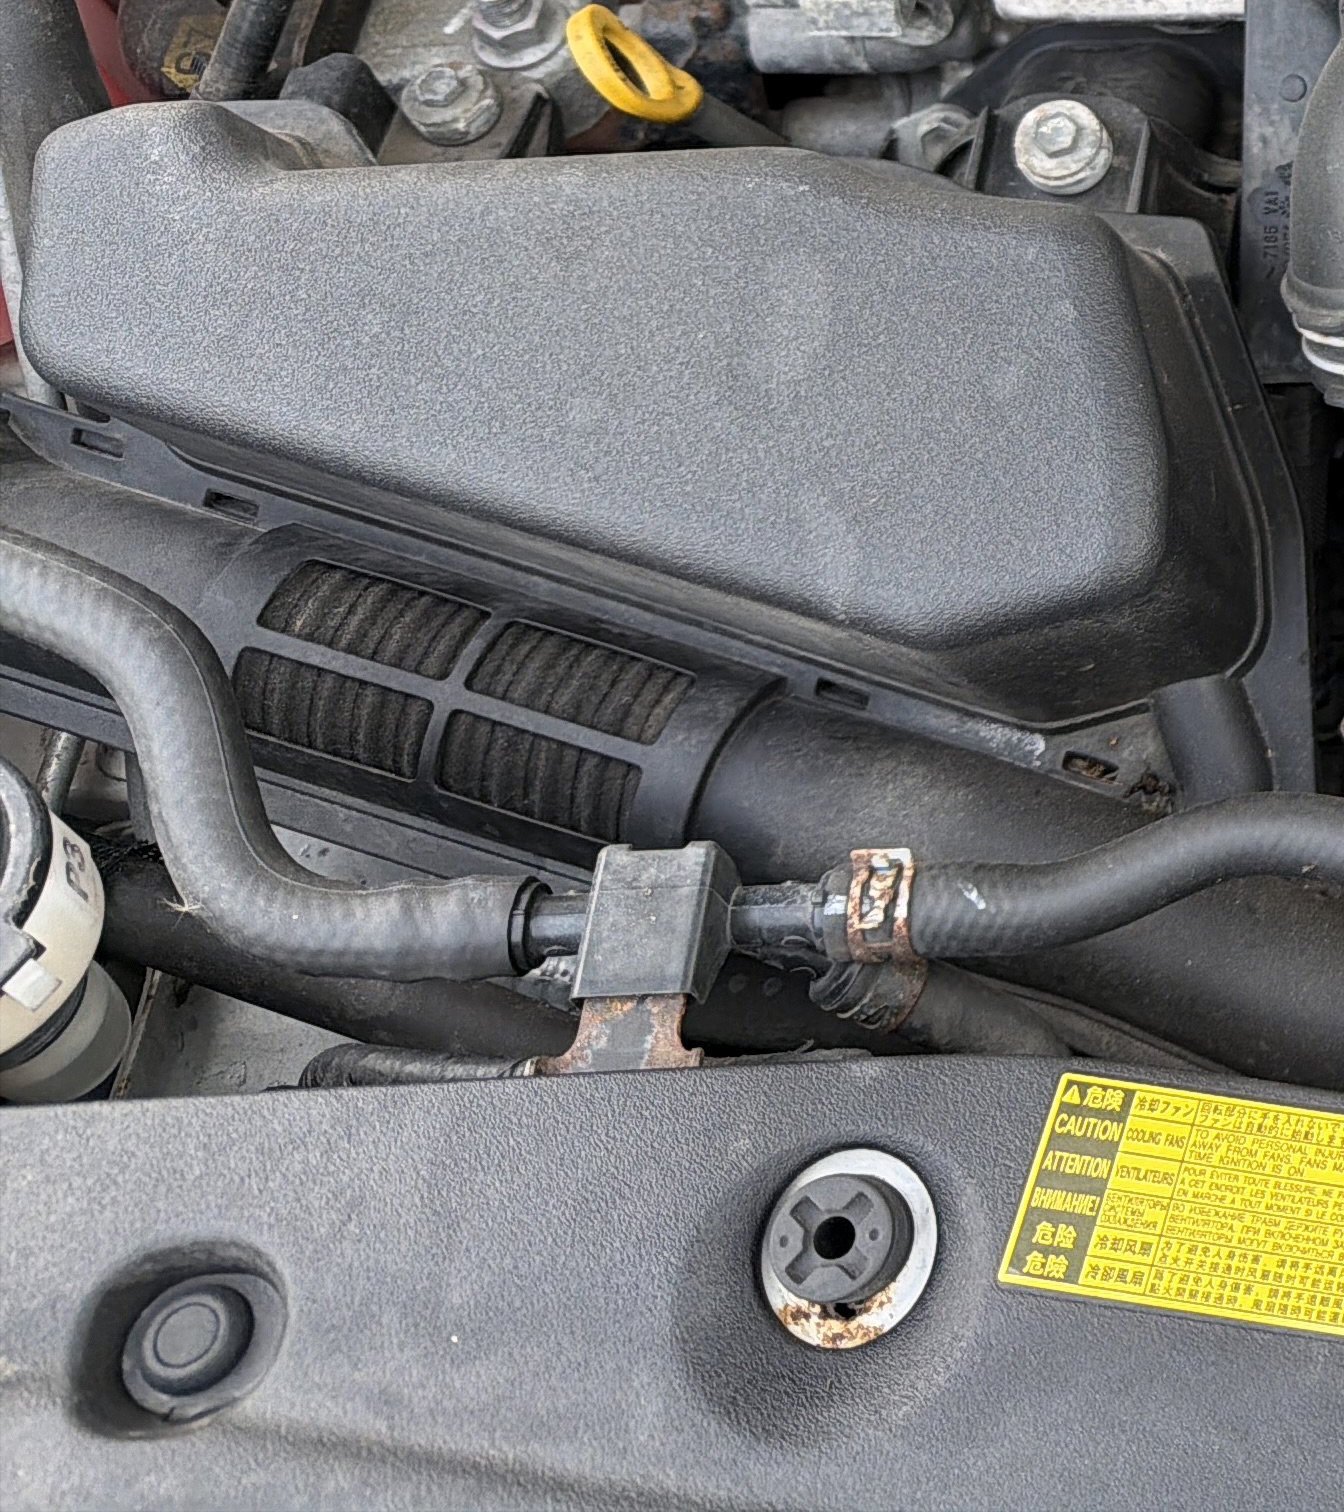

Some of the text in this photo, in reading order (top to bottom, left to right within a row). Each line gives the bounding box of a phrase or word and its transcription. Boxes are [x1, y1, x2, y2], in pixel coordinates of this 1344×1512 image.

[1081, 1085, 1126, 1111] 危険
[1052, 1112, 1123, 1142] CAUTION
[1124, 1126, 1187, 1149] COOLING FANS
[1193, 1128, 1209, 1140] TO
[1212, 1131, 1247, 1145] AVOID
[1251, 1137, 1309, 1155] PERSONAL
[1041, 1149, 1112, 1179] ATTENTION
[1190, 1139, 1221, 1153] AWAY
[1225, 1144, 1258, 1159] FROM
[1298, 1156, 1328, 1170] FANS
[1270, 1162, 1282, 1174] IS
[1113, 1164, 1176, 1186] VENTILATEURS
[1029, 1186, 1101, 1216] ВНИМАНИЕ!
[1030, 1219, 1080, 1249] 危险
[1021, 1249, 1071, 1279] 危險
